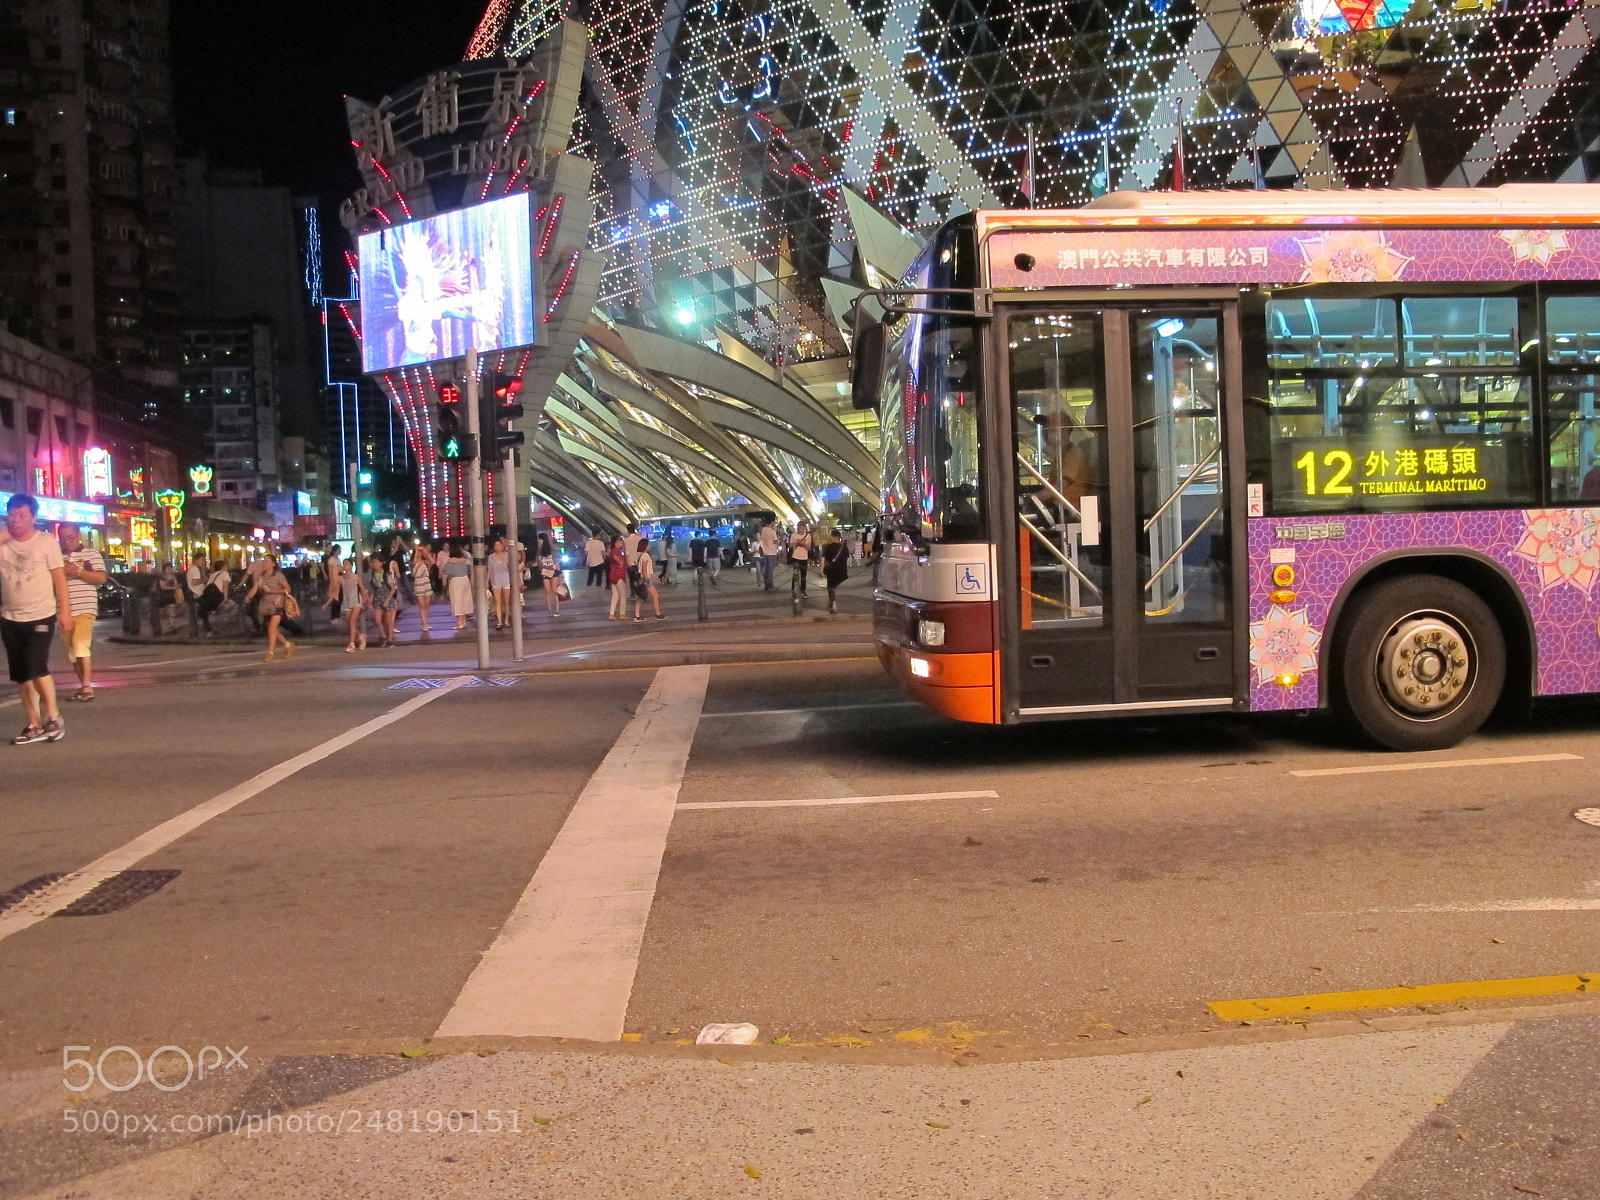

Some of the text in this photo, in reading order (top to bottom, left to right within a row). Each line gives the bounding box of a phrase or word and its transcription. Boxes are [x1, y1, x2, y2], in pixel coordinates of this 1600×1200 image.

[354, 57, 538, 158] 新葡京
[339, 138, 549, 228] GRAND LISBOA
[1057, 247, 1269, 270] 澳門公共汽車有限公司
[1296, 450, 1354, 495] 12
[1365, 448, 1477, 477] 外港碼頭
[1250, 488, 1261, 499] 上
[1360, 477, 1487, 494] TERMINAL MARÍTIMO
